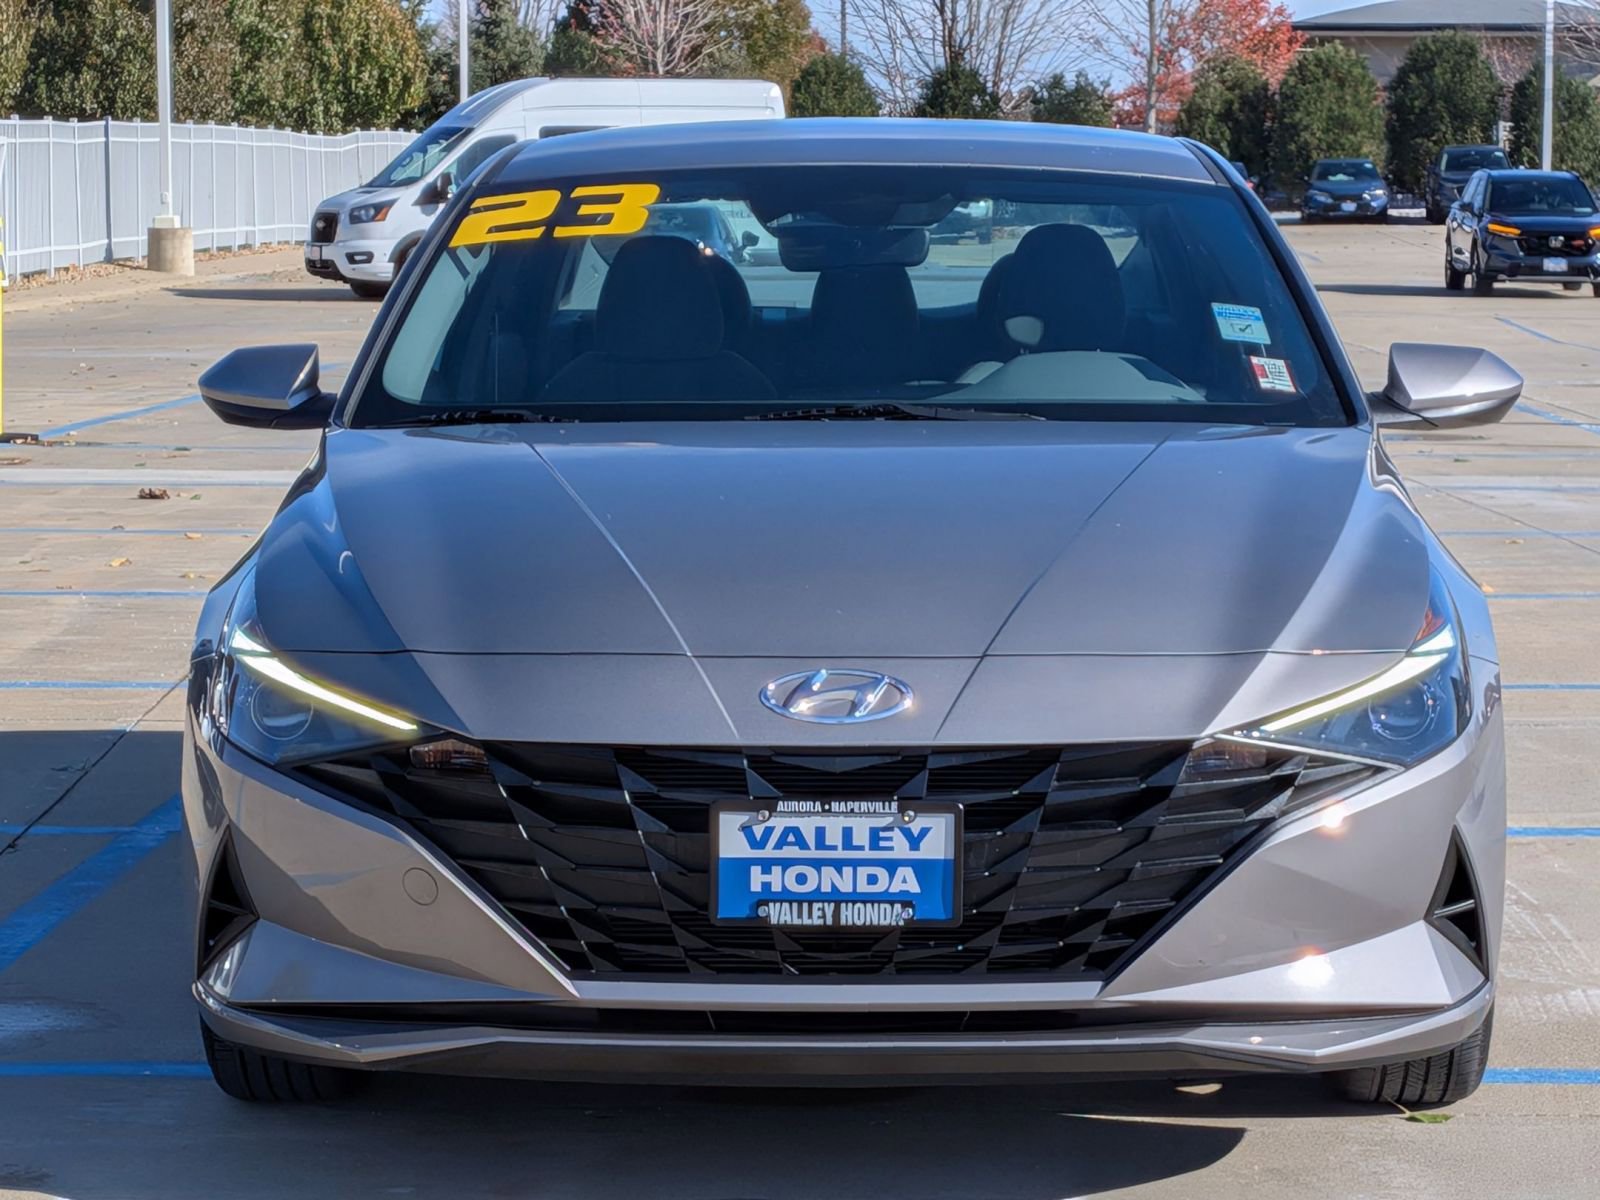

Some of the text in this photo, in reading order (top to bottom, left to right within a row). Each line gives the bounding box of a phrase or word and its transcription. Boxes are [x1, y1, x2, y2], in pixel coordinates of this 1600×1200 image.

[448, 184, 660, 247] 23
[777, 801, 898, 813] AURORA NAPERVILLE
[741, 826, 933, 851] VALLEY
[750, 865, 921, 893] HONDA
[768, 902, 904, 925] VALLEY HONDA
